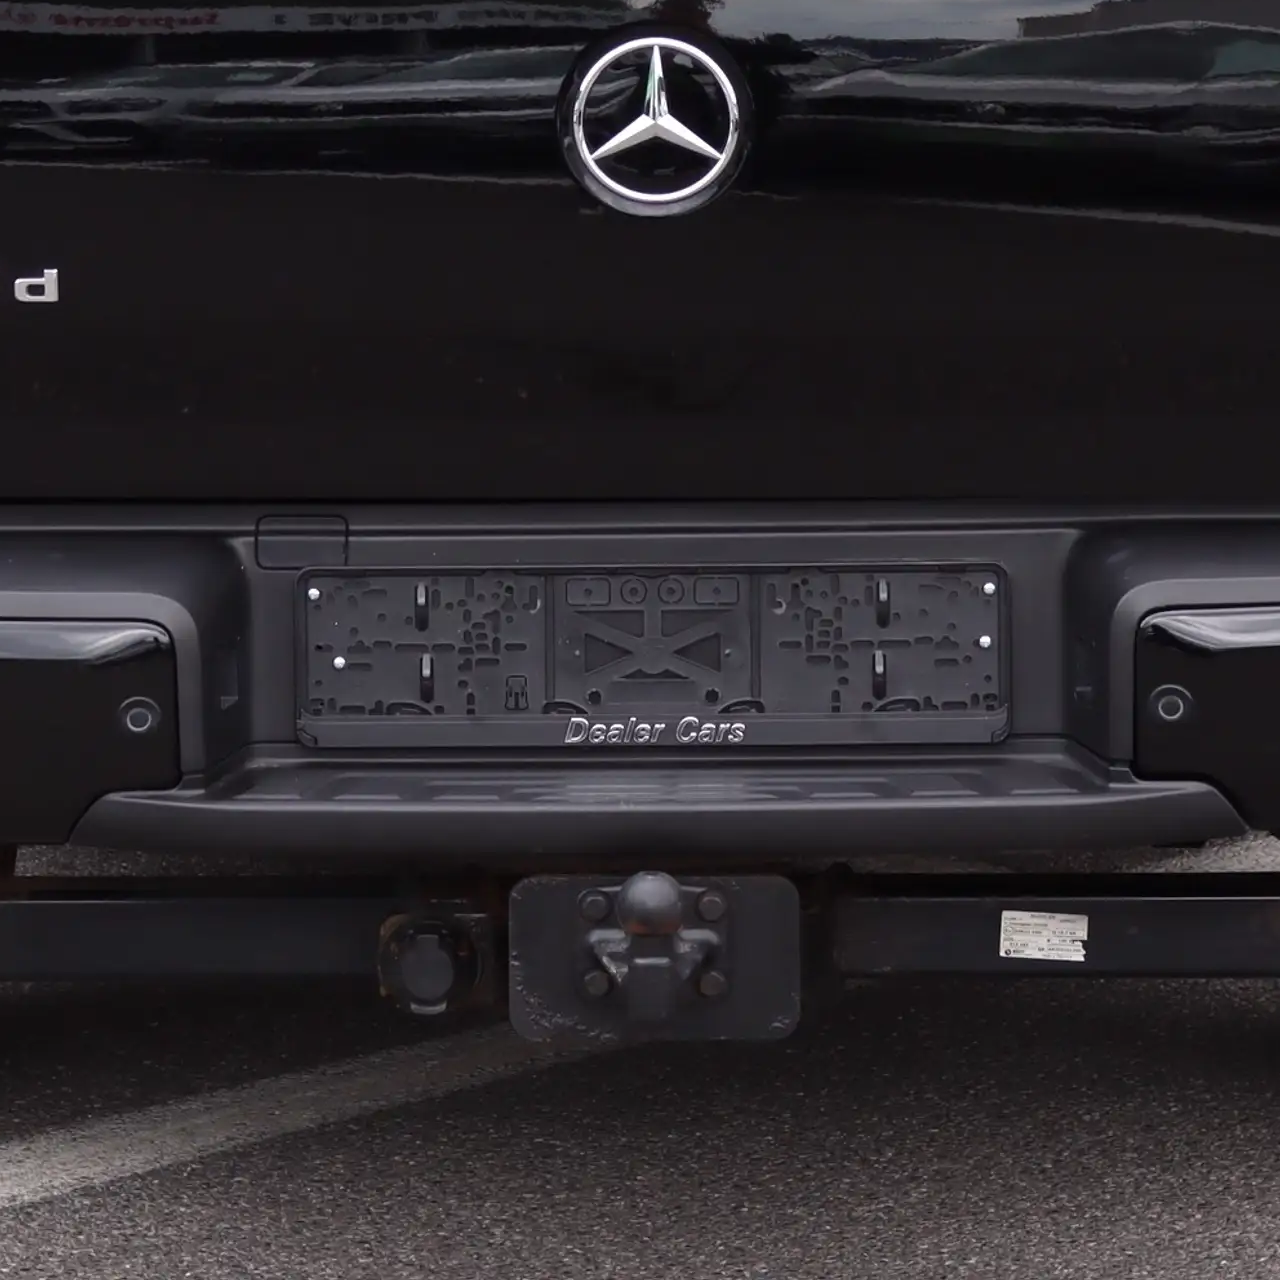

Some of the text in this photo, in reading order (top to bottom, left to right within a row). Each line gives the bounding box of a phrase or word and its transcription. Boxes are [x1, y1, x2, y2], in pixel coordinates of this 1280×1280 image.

[13, 268, 59, 303] d
[564, 715, 747, 745] Dealer Cars
